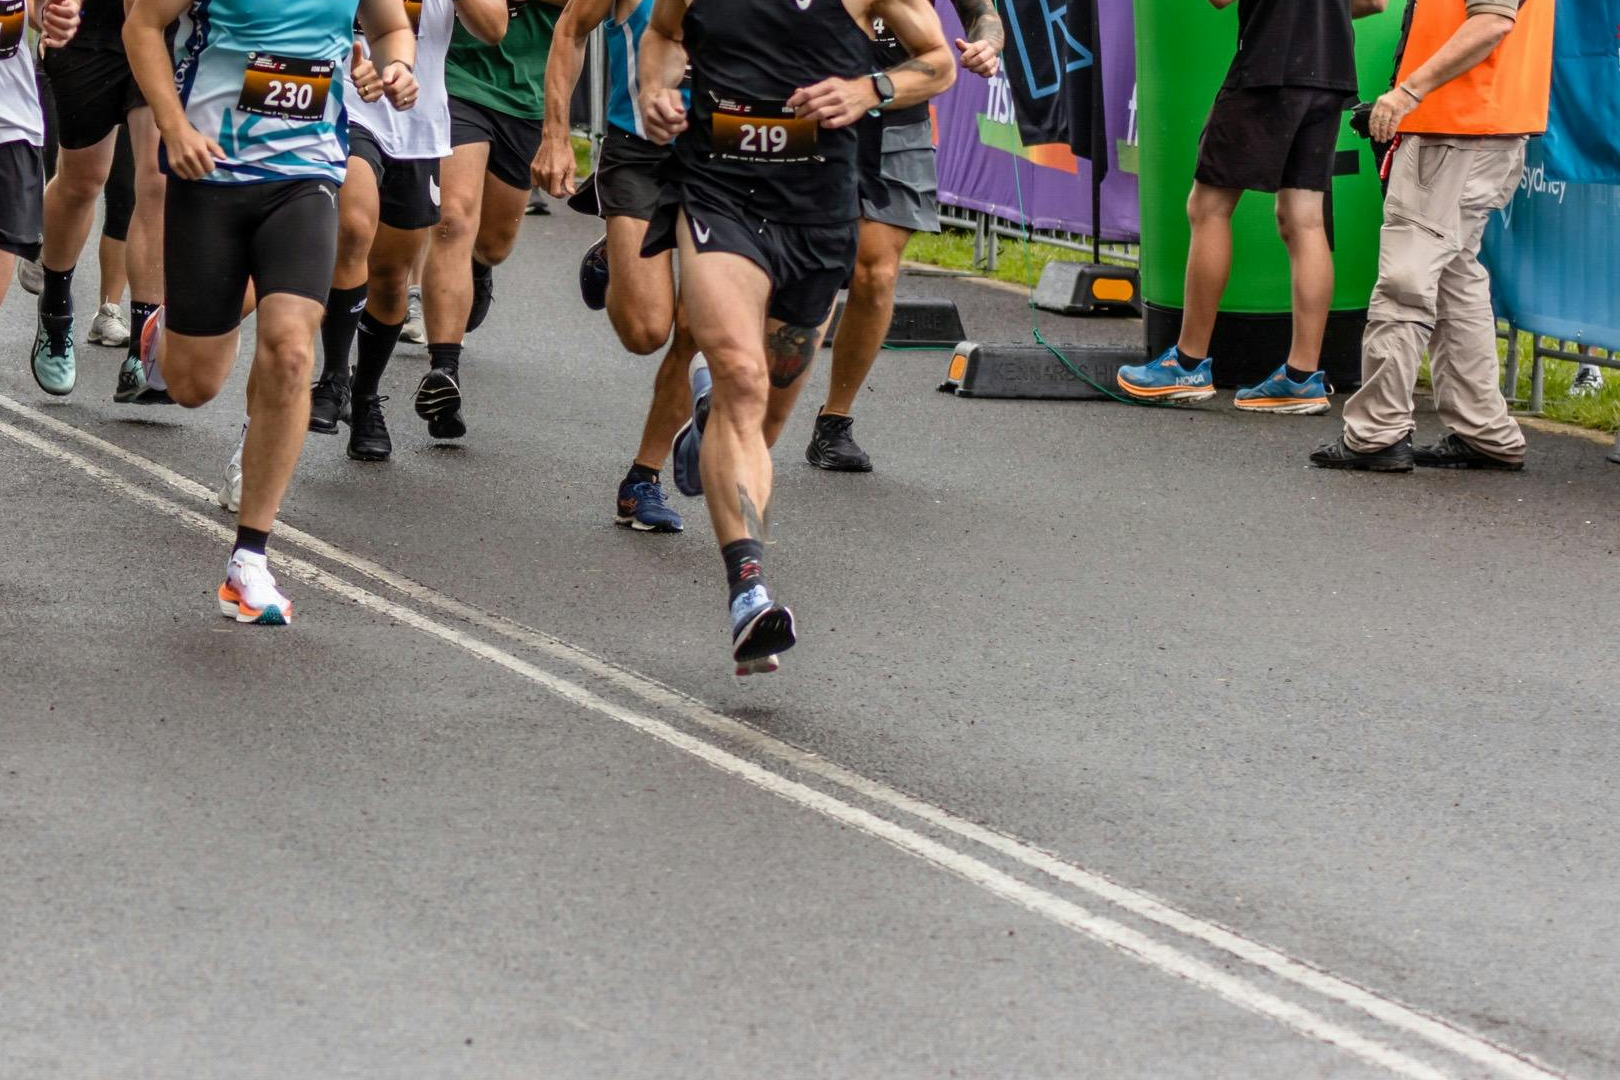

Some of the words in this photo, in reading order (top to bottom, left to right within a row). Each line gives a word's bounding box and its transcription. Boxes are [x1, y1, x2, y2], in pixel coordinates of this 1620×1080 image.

[264, 79, 314, 110] 230
[740, 124, 788, 153] 219
[1175, 372, 1205, 387] HOKA
